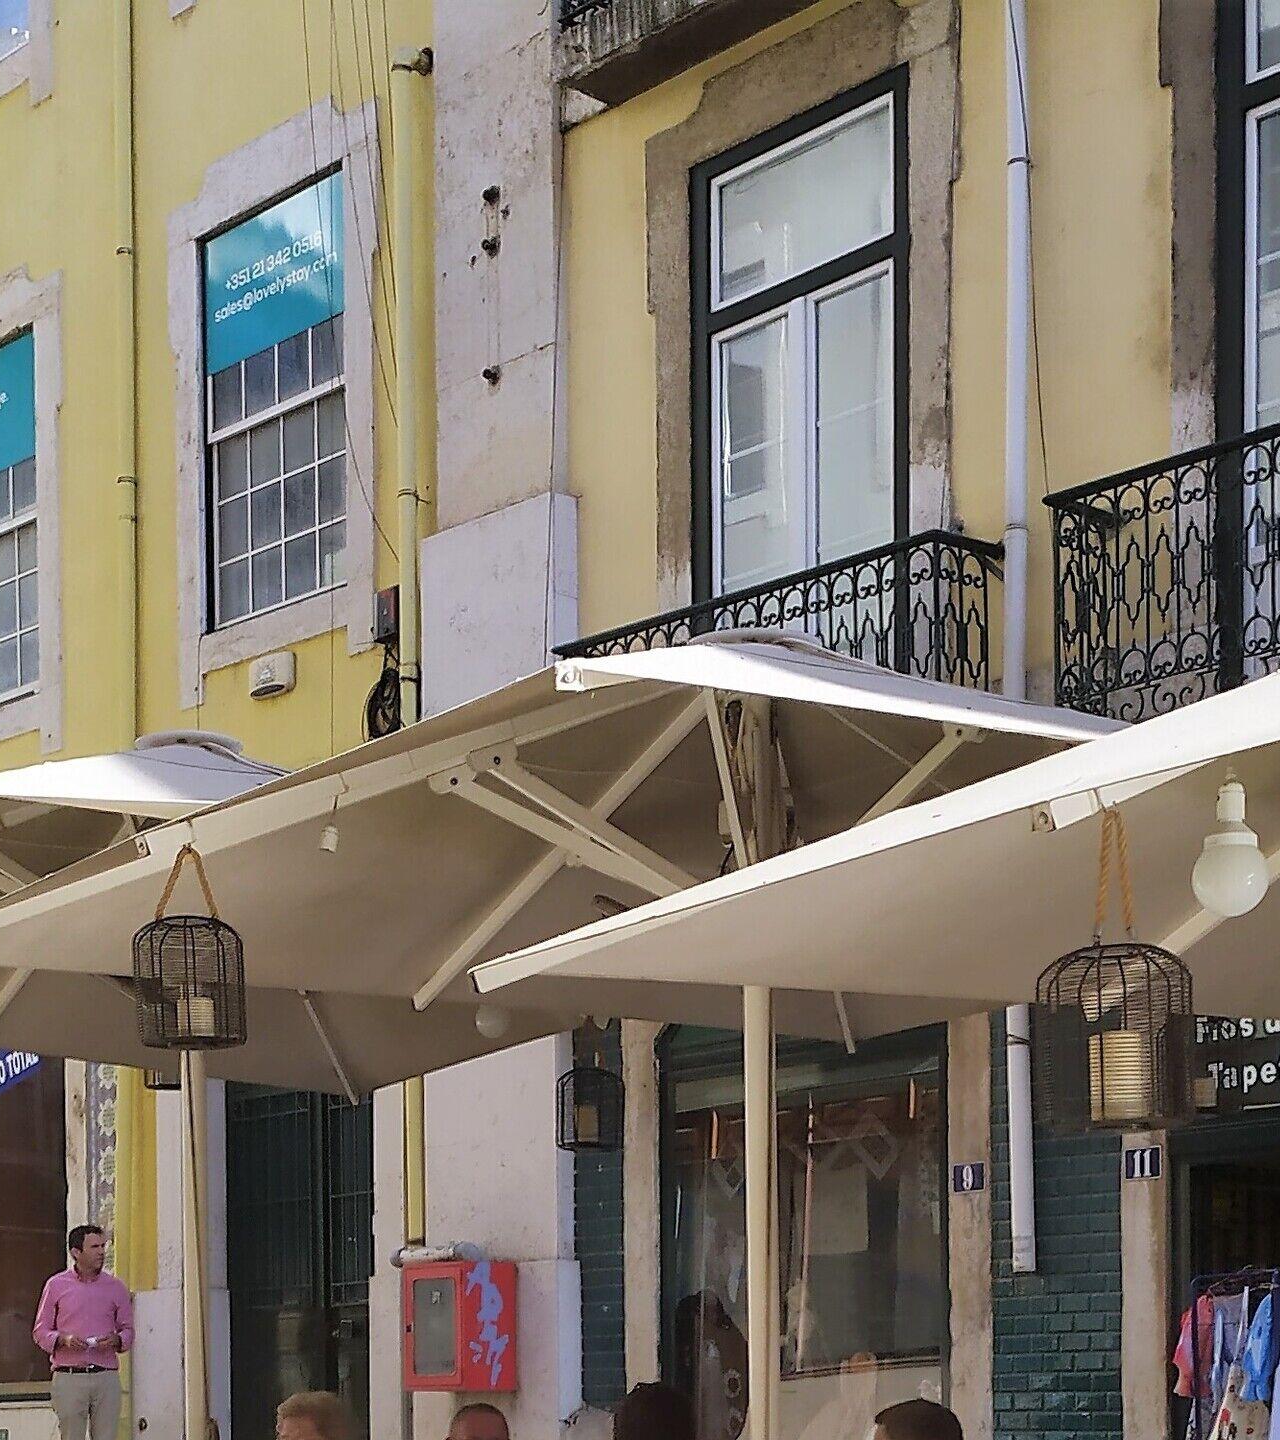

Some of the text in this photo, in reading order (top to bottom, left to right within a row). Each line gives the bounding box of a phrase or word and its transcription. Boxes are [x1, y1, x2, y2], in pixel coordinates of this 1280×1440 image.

[214, 251, 337, 323] sales@lovelystay.com
[225, 268, 251, 291] +351
[251, 260, 265, 280] 21
[266, 246, 291, 273] 342
[962, 1165, 974, 1190] 9
[1132, 1149, 1152, 1178] 11
